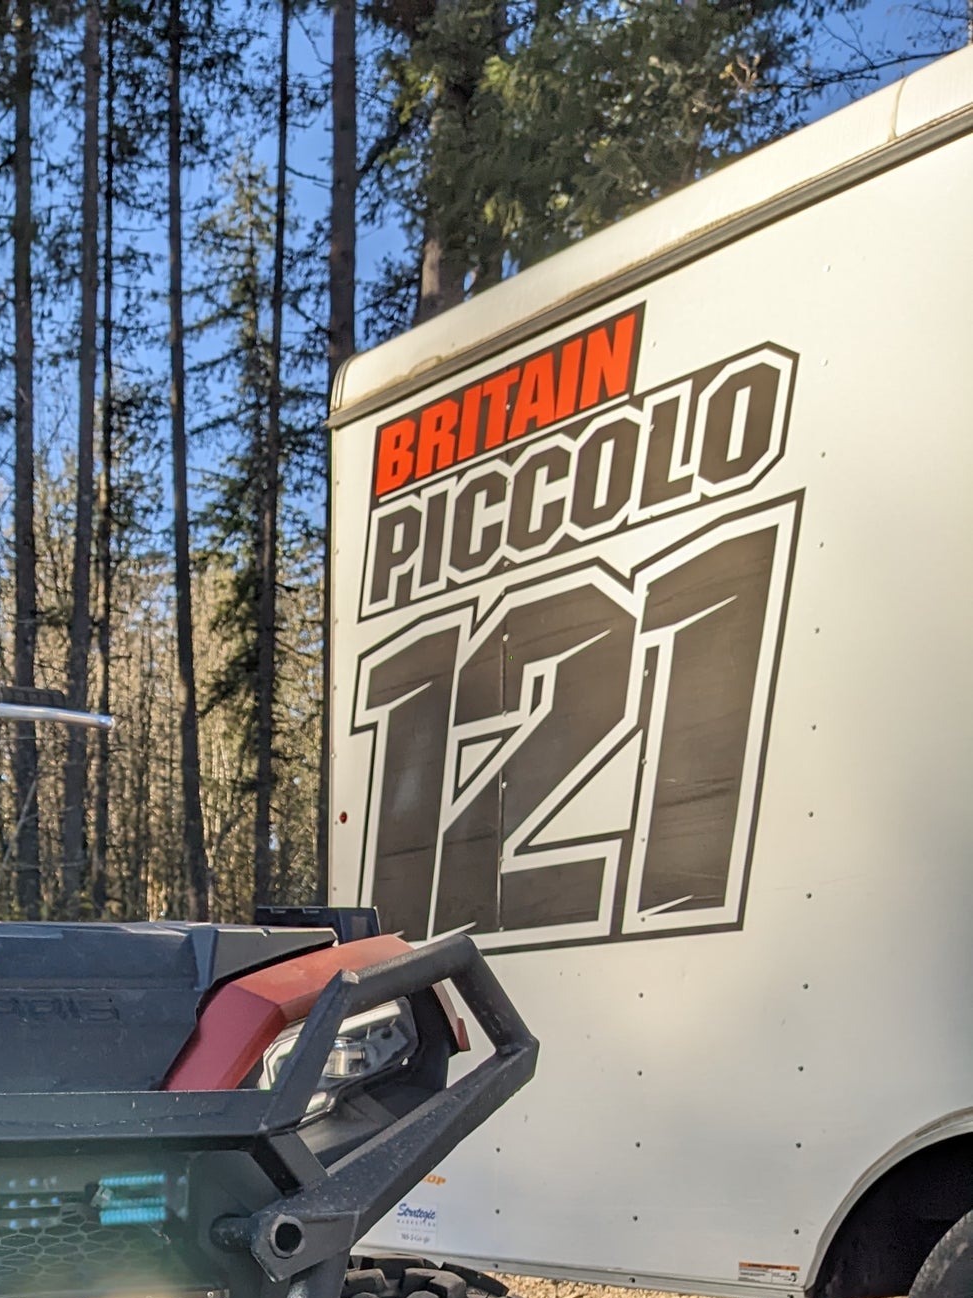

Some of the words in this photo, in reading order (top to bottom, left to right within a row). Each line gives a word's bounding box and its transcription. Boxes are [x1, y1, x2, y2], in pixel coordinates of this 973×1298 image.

[365, 354, 789, 604] PICCOLO
[374, 312, 639, 497] BRITAIN
[355, 502, 799, 945] 121
[397, 1202, 436, 1222] Strategic
